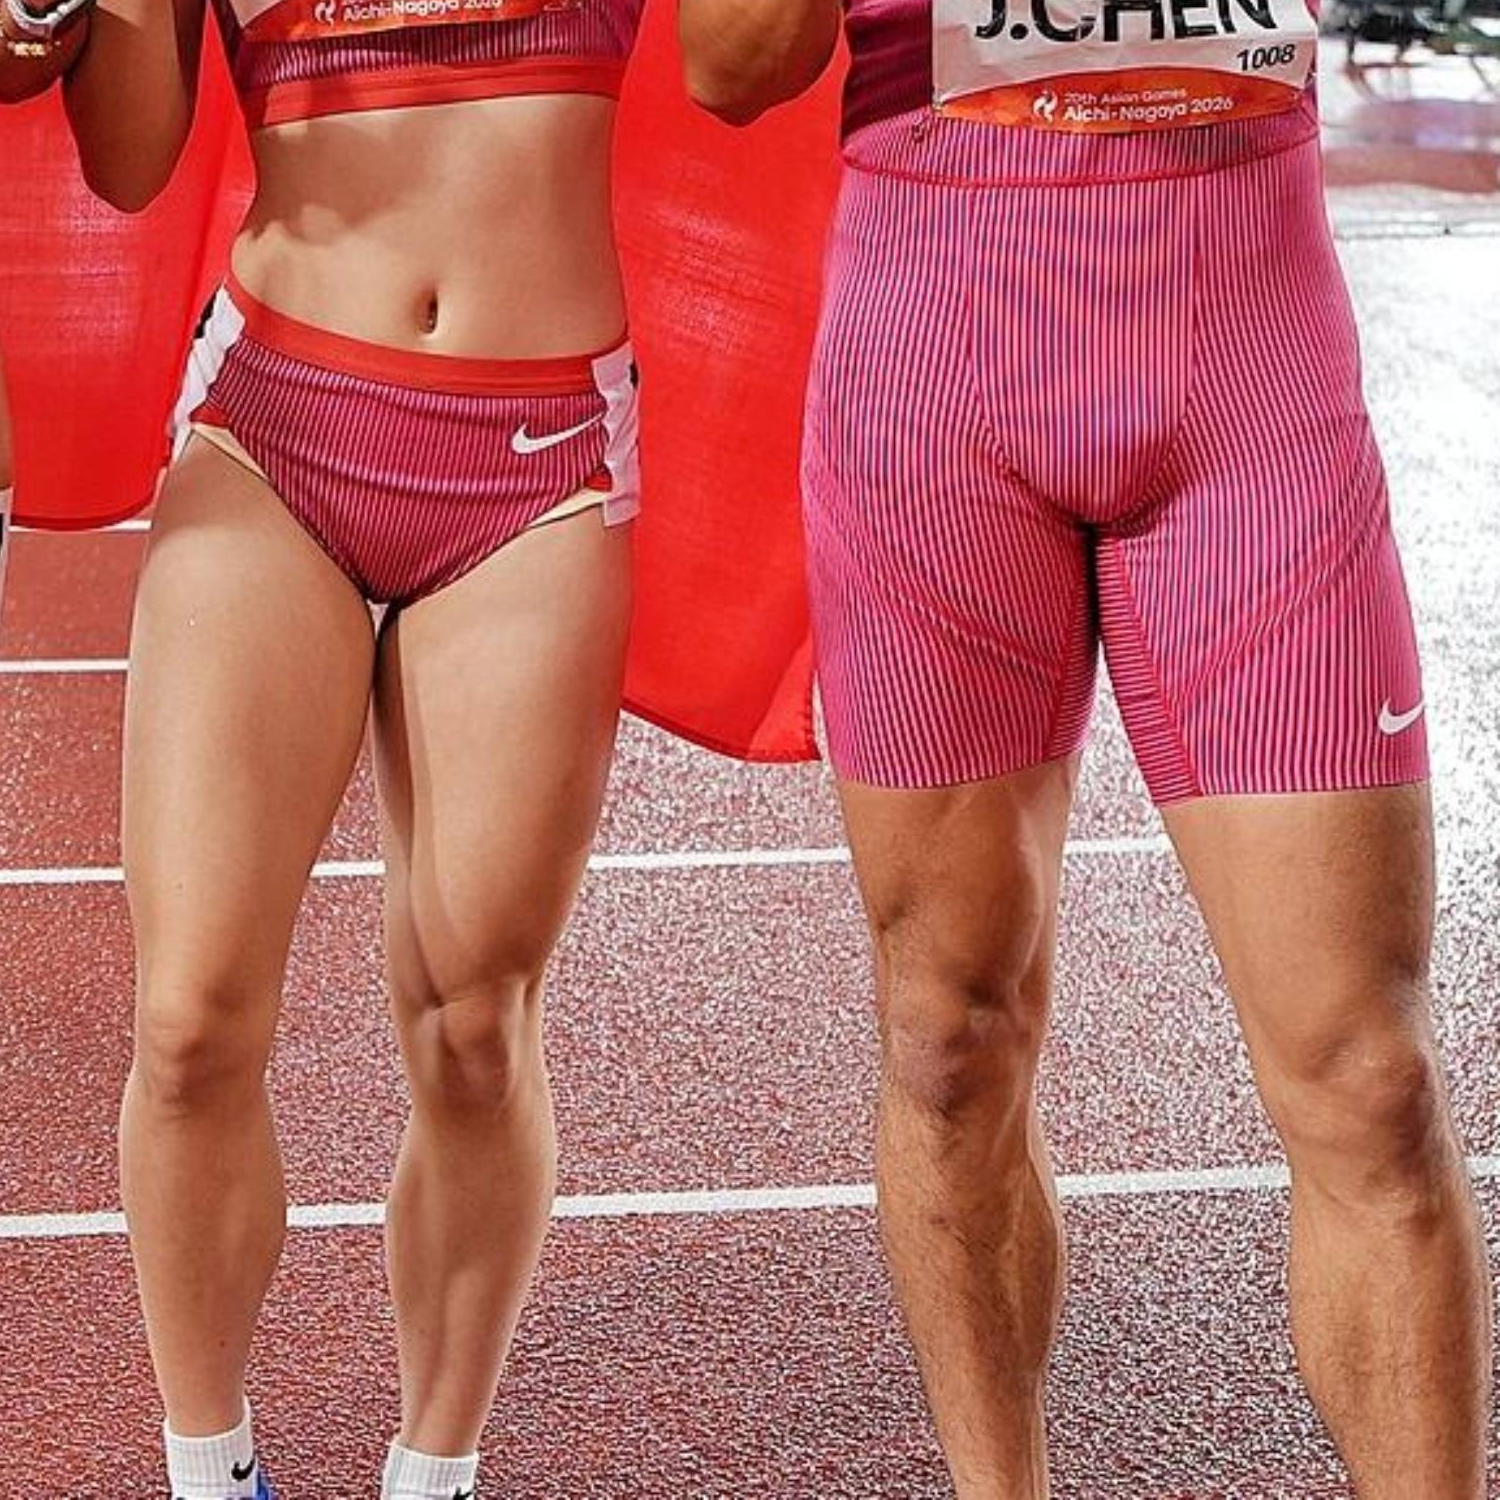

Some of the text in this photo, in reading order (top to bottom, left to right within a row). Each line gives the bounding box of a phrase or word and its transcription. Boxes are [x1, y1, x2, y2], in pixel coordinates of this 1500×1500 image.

[1236, 44, 1296, 71] 1008
[1064, 88, 1186, 105] 20th Asian Games
[1063, 97, 1234, 123] Aichi-Nagoya 2026
